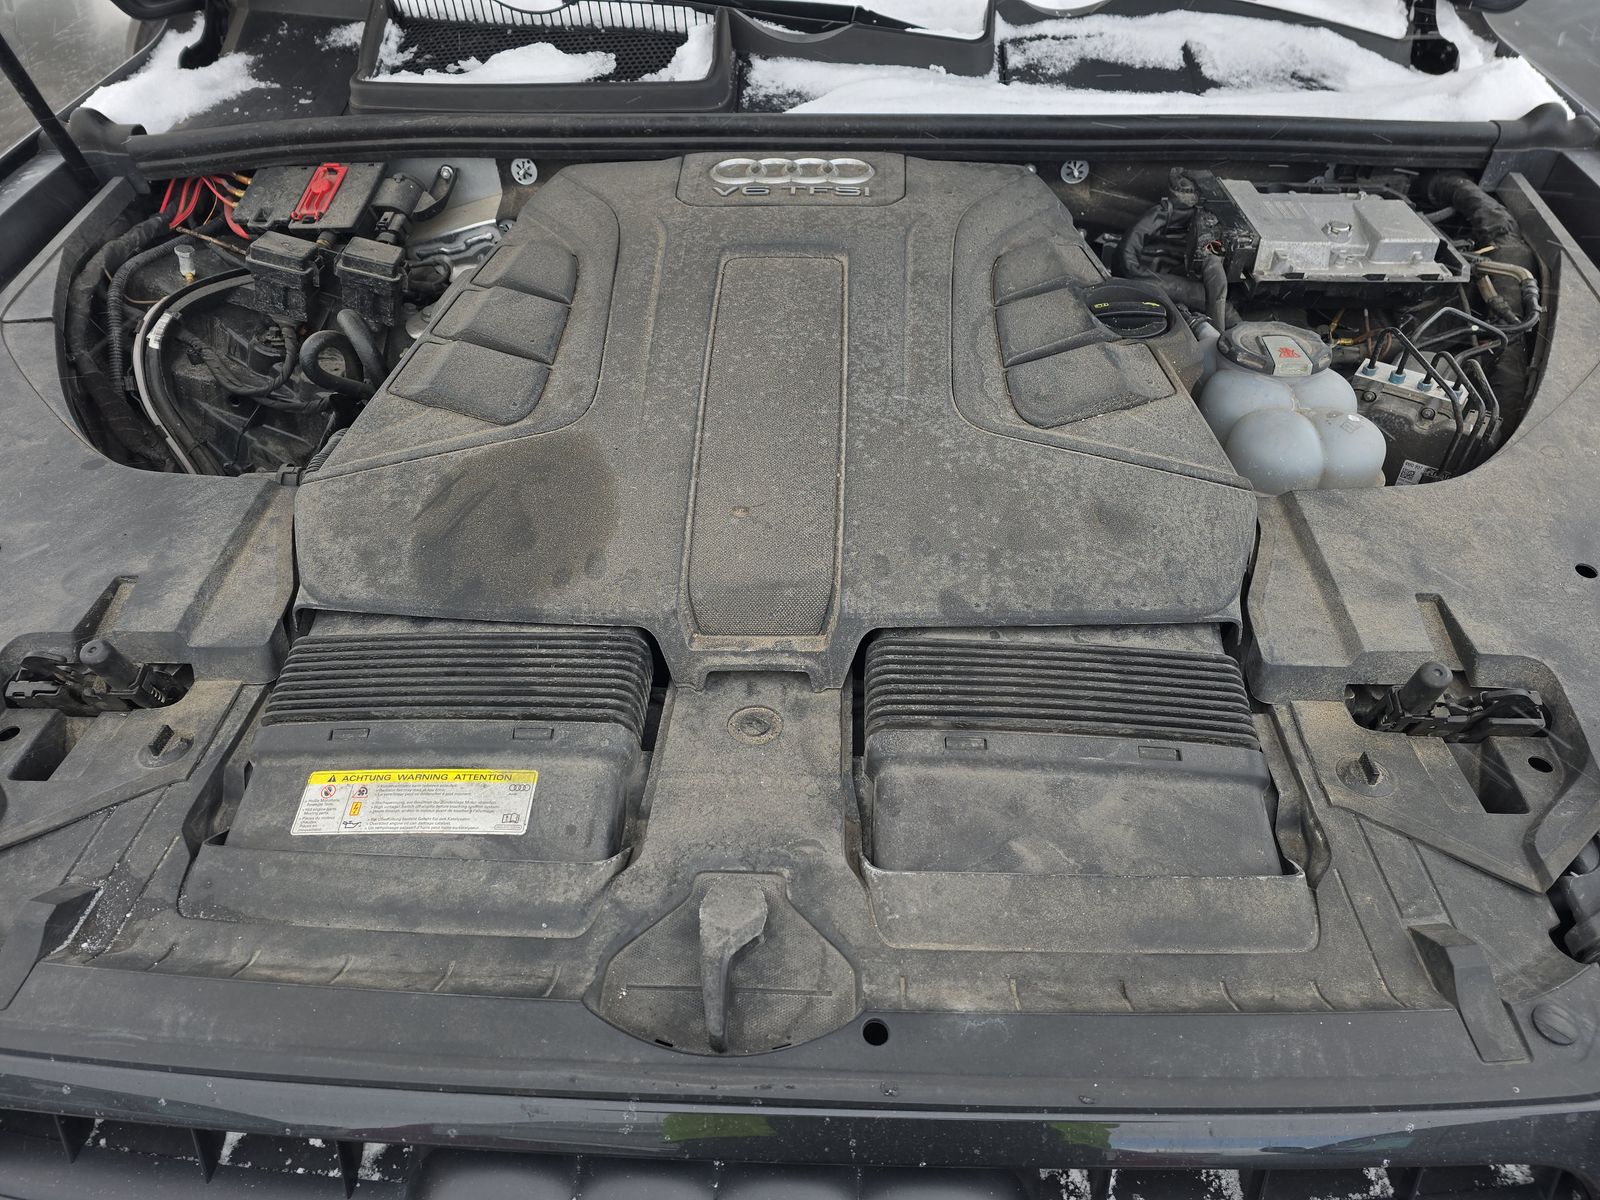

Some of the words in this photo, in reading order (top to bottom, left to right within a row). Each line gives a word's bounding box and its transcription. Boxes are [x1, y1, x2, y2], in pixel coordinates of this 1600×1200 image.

[712, 186, 770, 197] V6
[781, 186, 870, 197] TFSI
[341, 774, 391, 782] ACHTUNG
[397, 773, 448, 781] WARNING
[453, 773, 512, 781] ATTENTION
